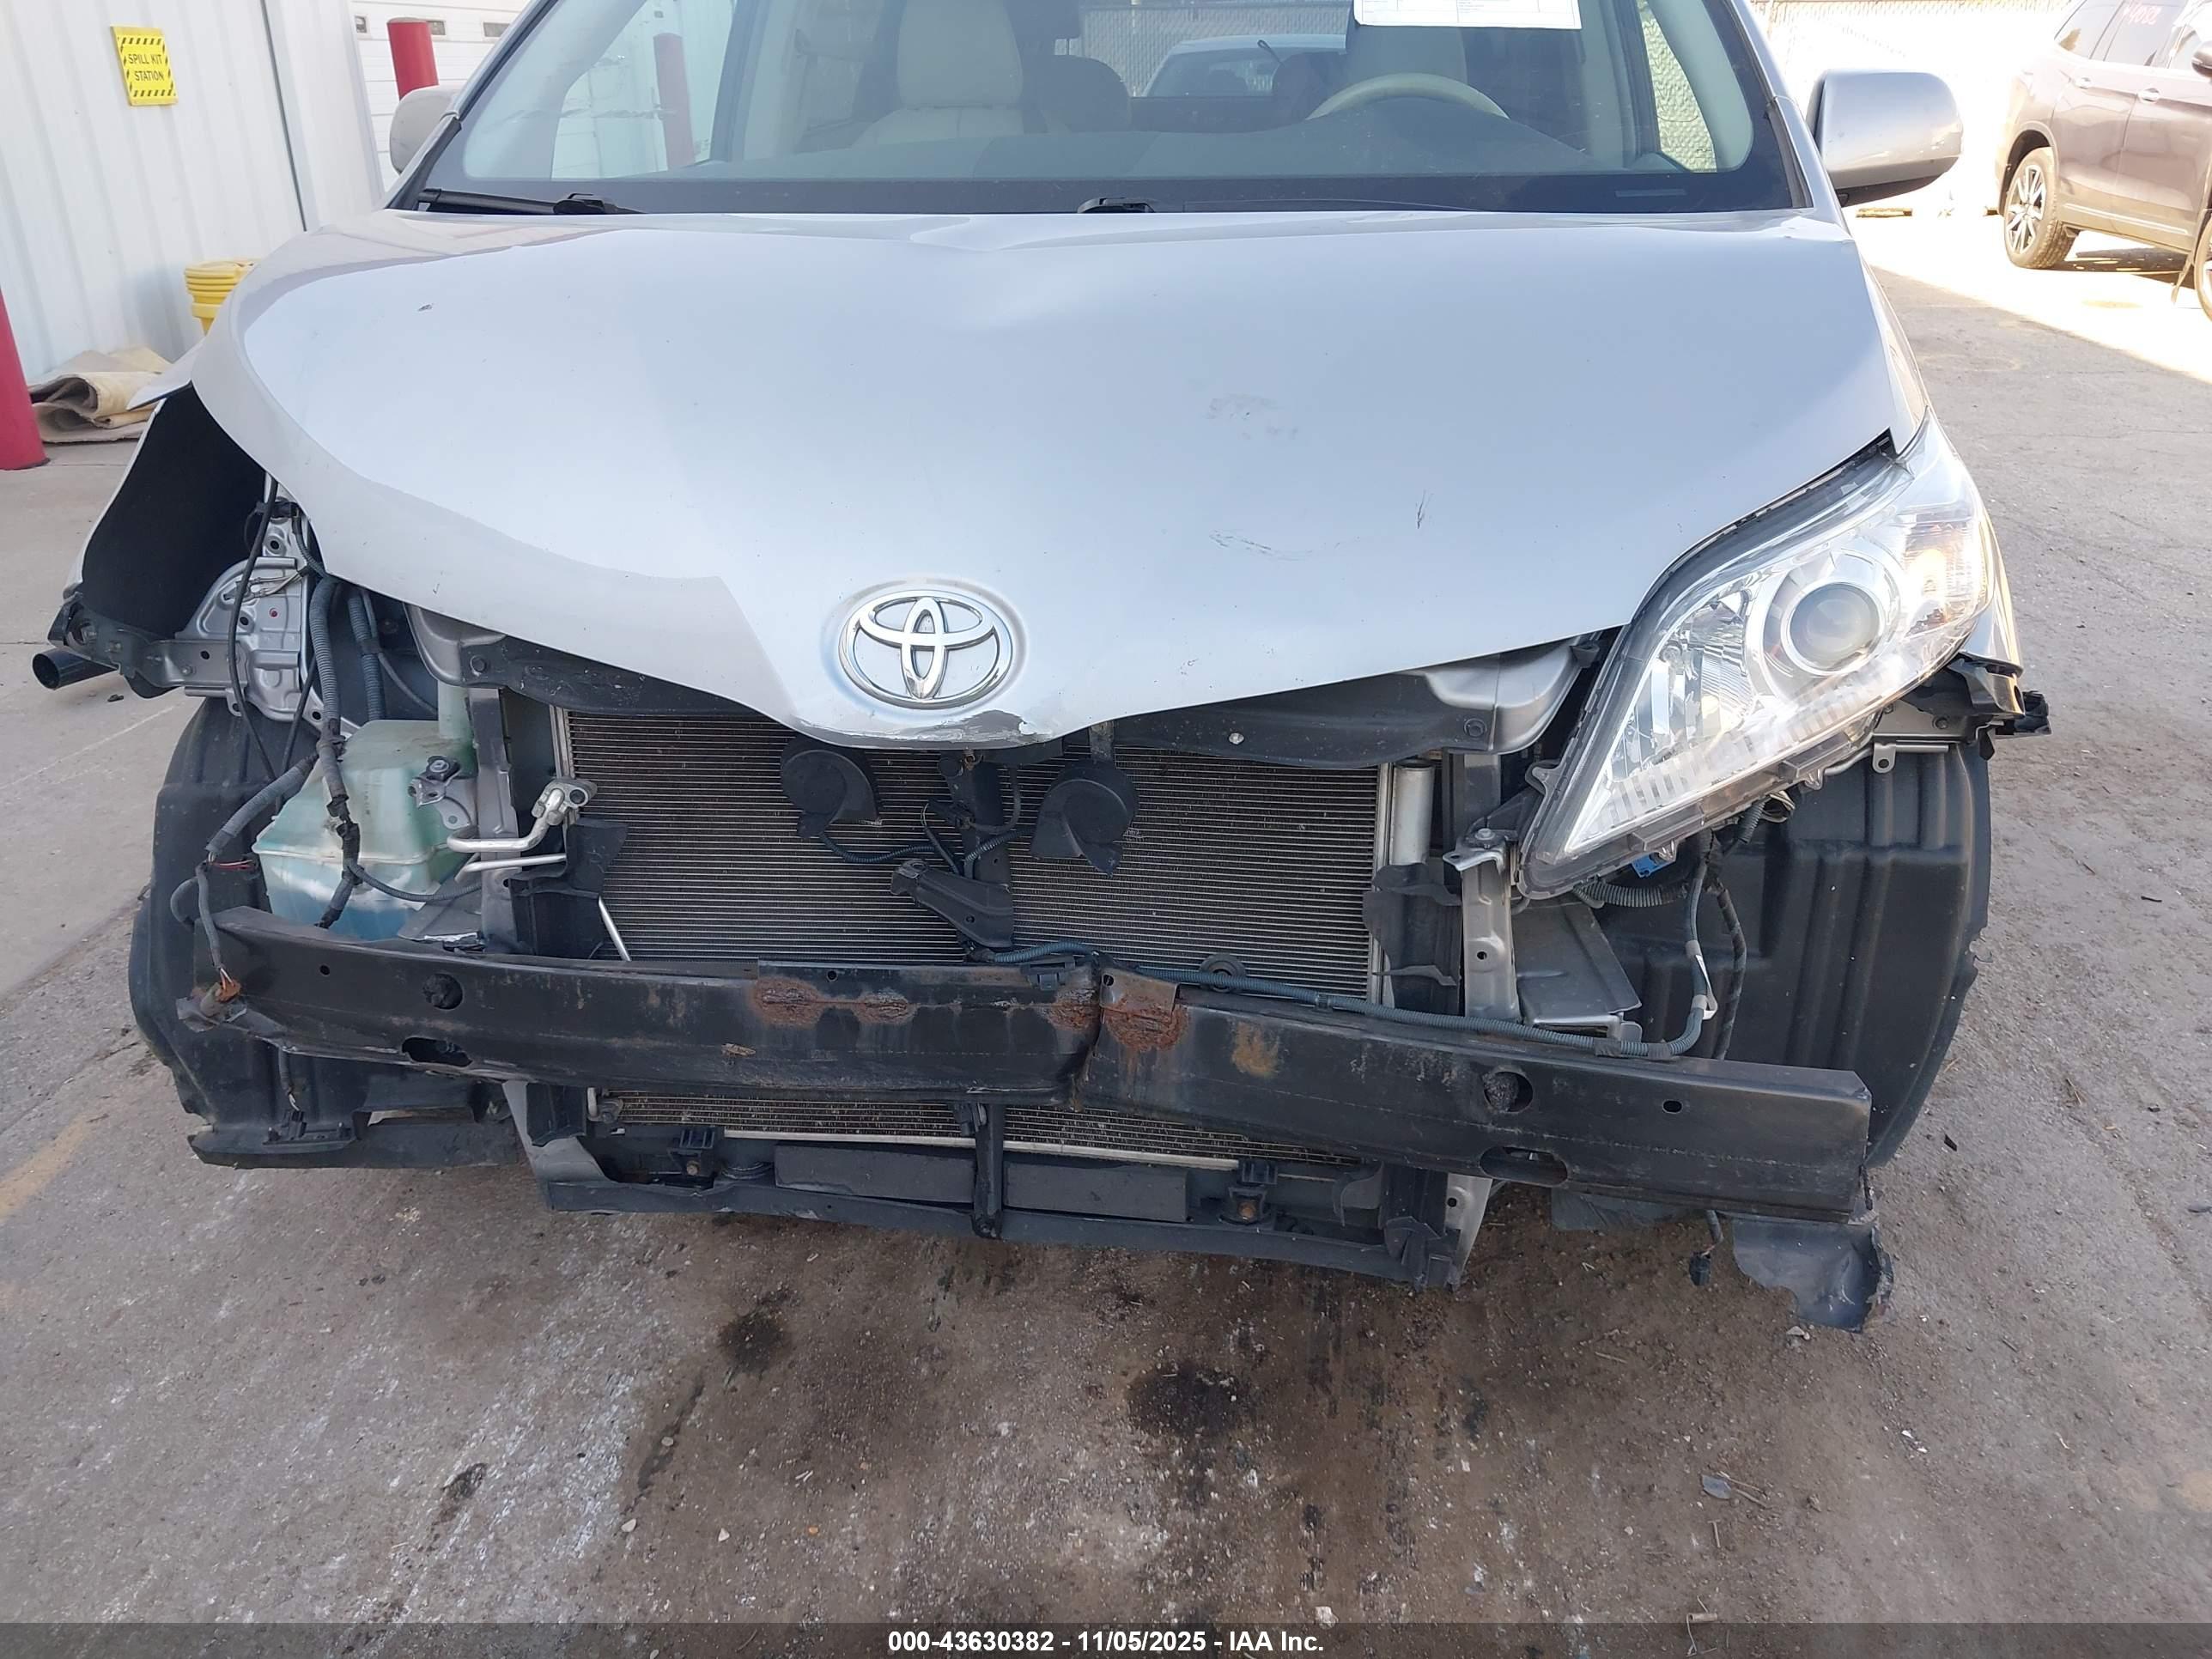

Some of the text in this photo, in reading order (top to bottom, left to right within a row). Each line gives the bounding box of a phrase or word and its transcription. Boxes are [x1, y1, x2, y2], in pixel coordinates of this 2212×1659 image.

[128, 53, 162, 64] SPILL KIT
[134, 70, 165, 81] STATION
